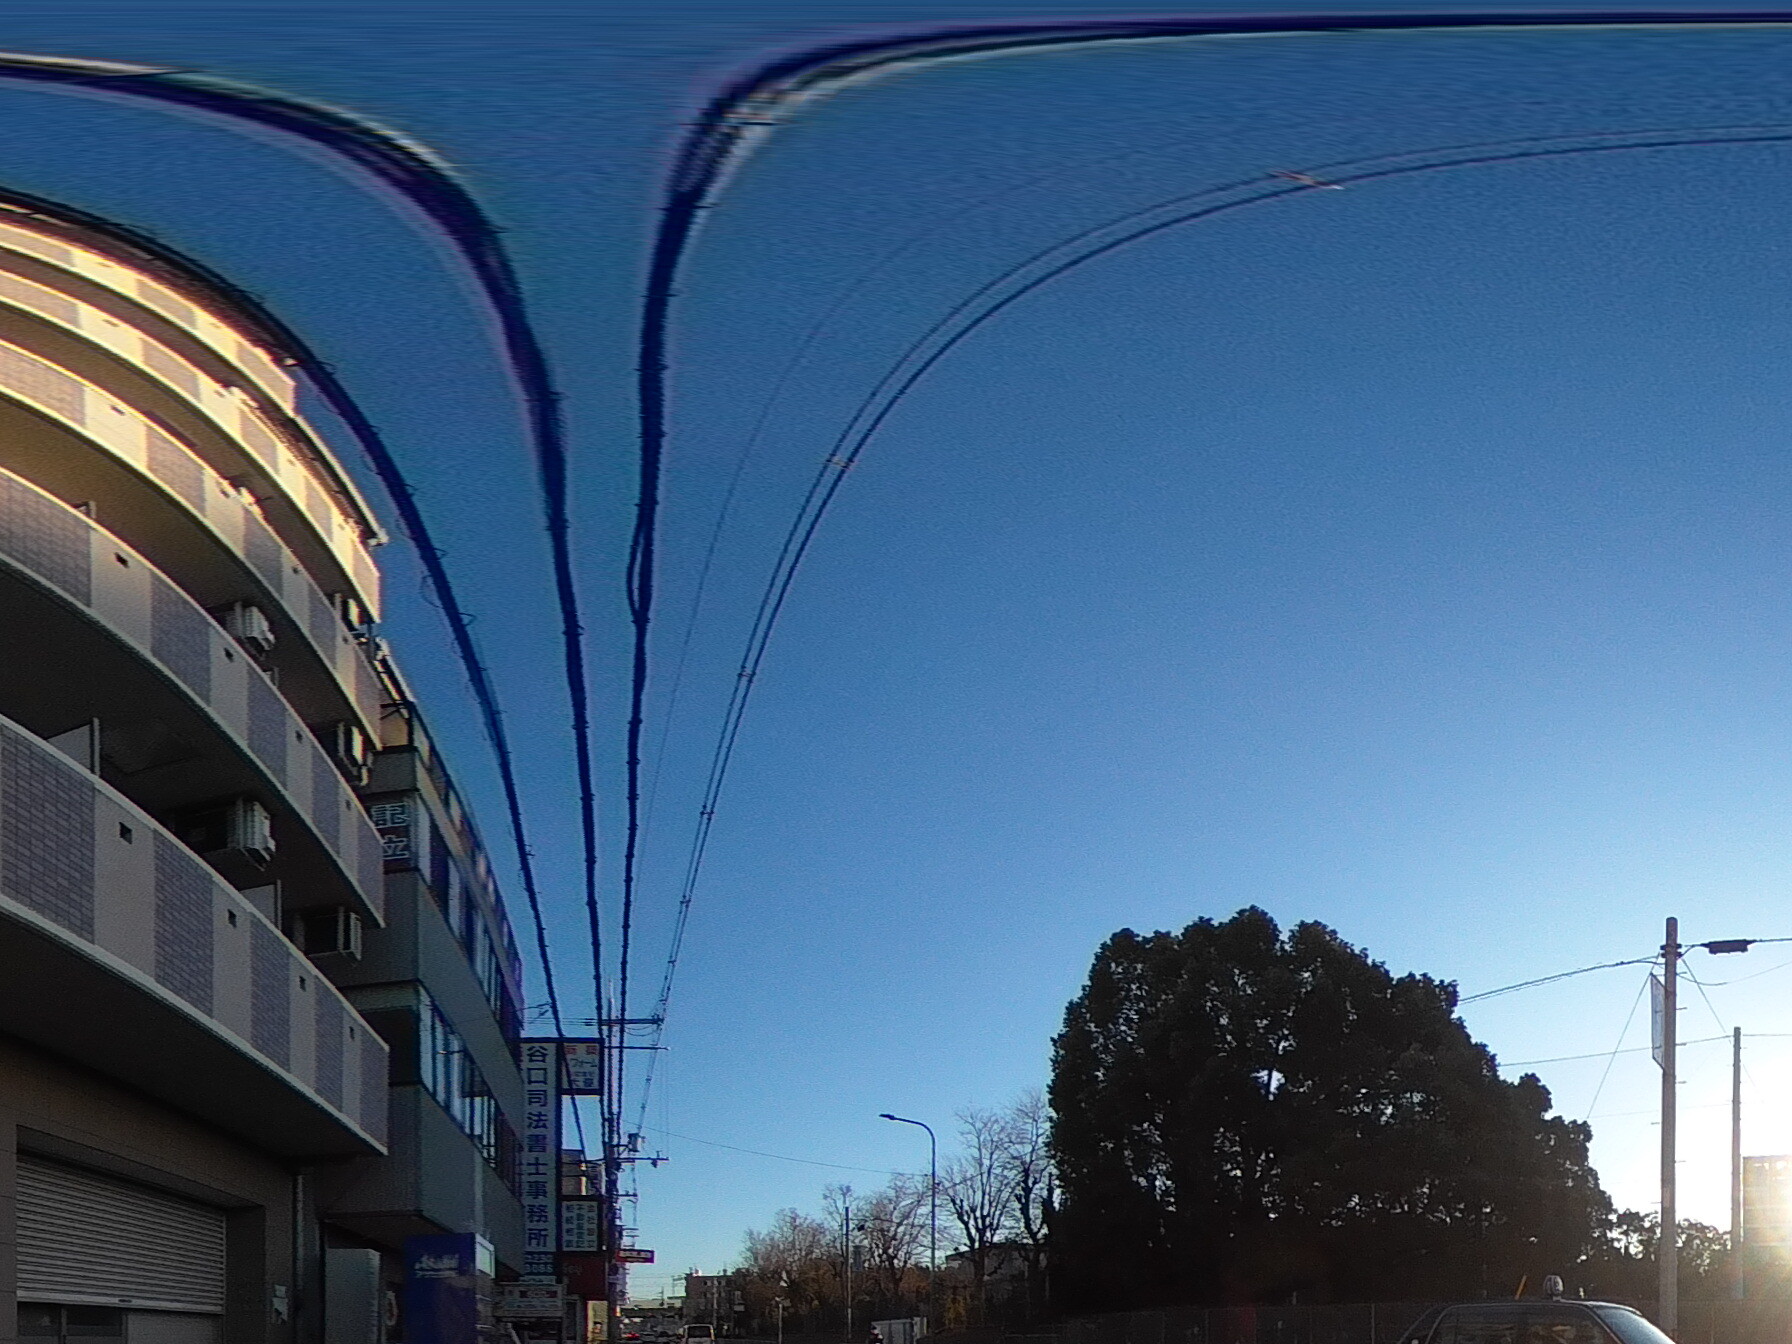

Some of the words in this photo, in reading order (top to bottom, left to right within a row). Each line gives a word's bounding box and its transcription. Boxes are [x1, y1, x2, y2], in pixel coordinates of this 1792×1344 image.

[526, 1045, 549, 1249] 谷口司法書士事務所
